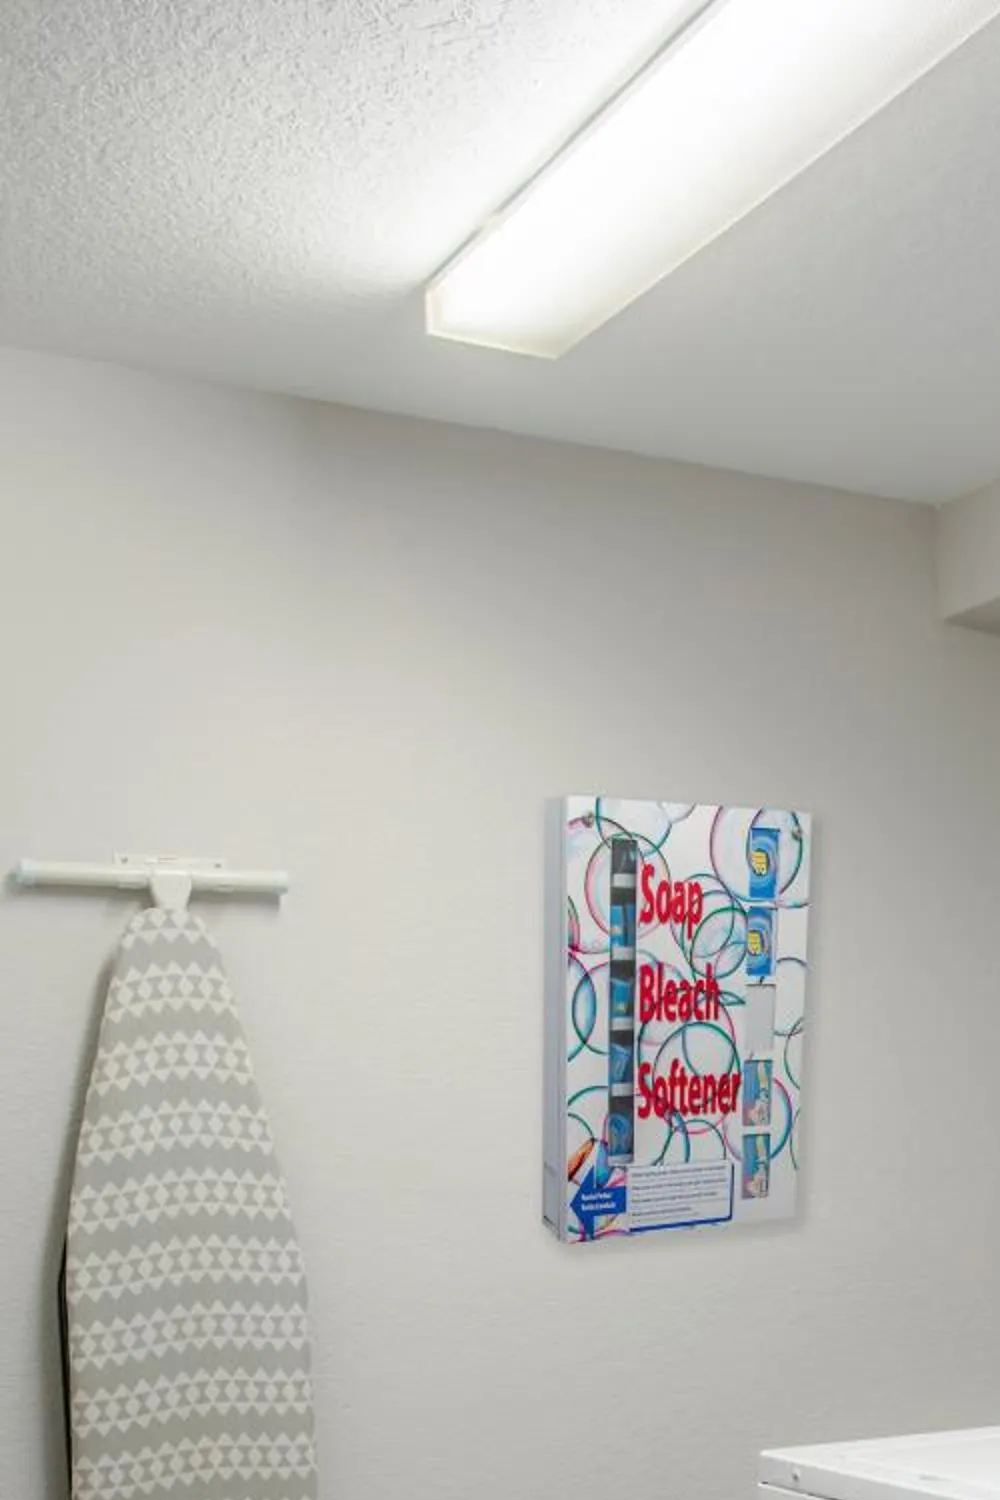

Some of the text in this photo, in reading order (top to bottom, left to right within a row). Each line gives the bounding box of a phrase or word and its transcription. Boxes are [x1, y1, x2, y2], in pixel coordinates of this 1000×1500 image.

[638, 863, 703, 940] Soap
[638, 961, 720, 1023] Bleach
[637, 1058, 741, 1119] Softener
